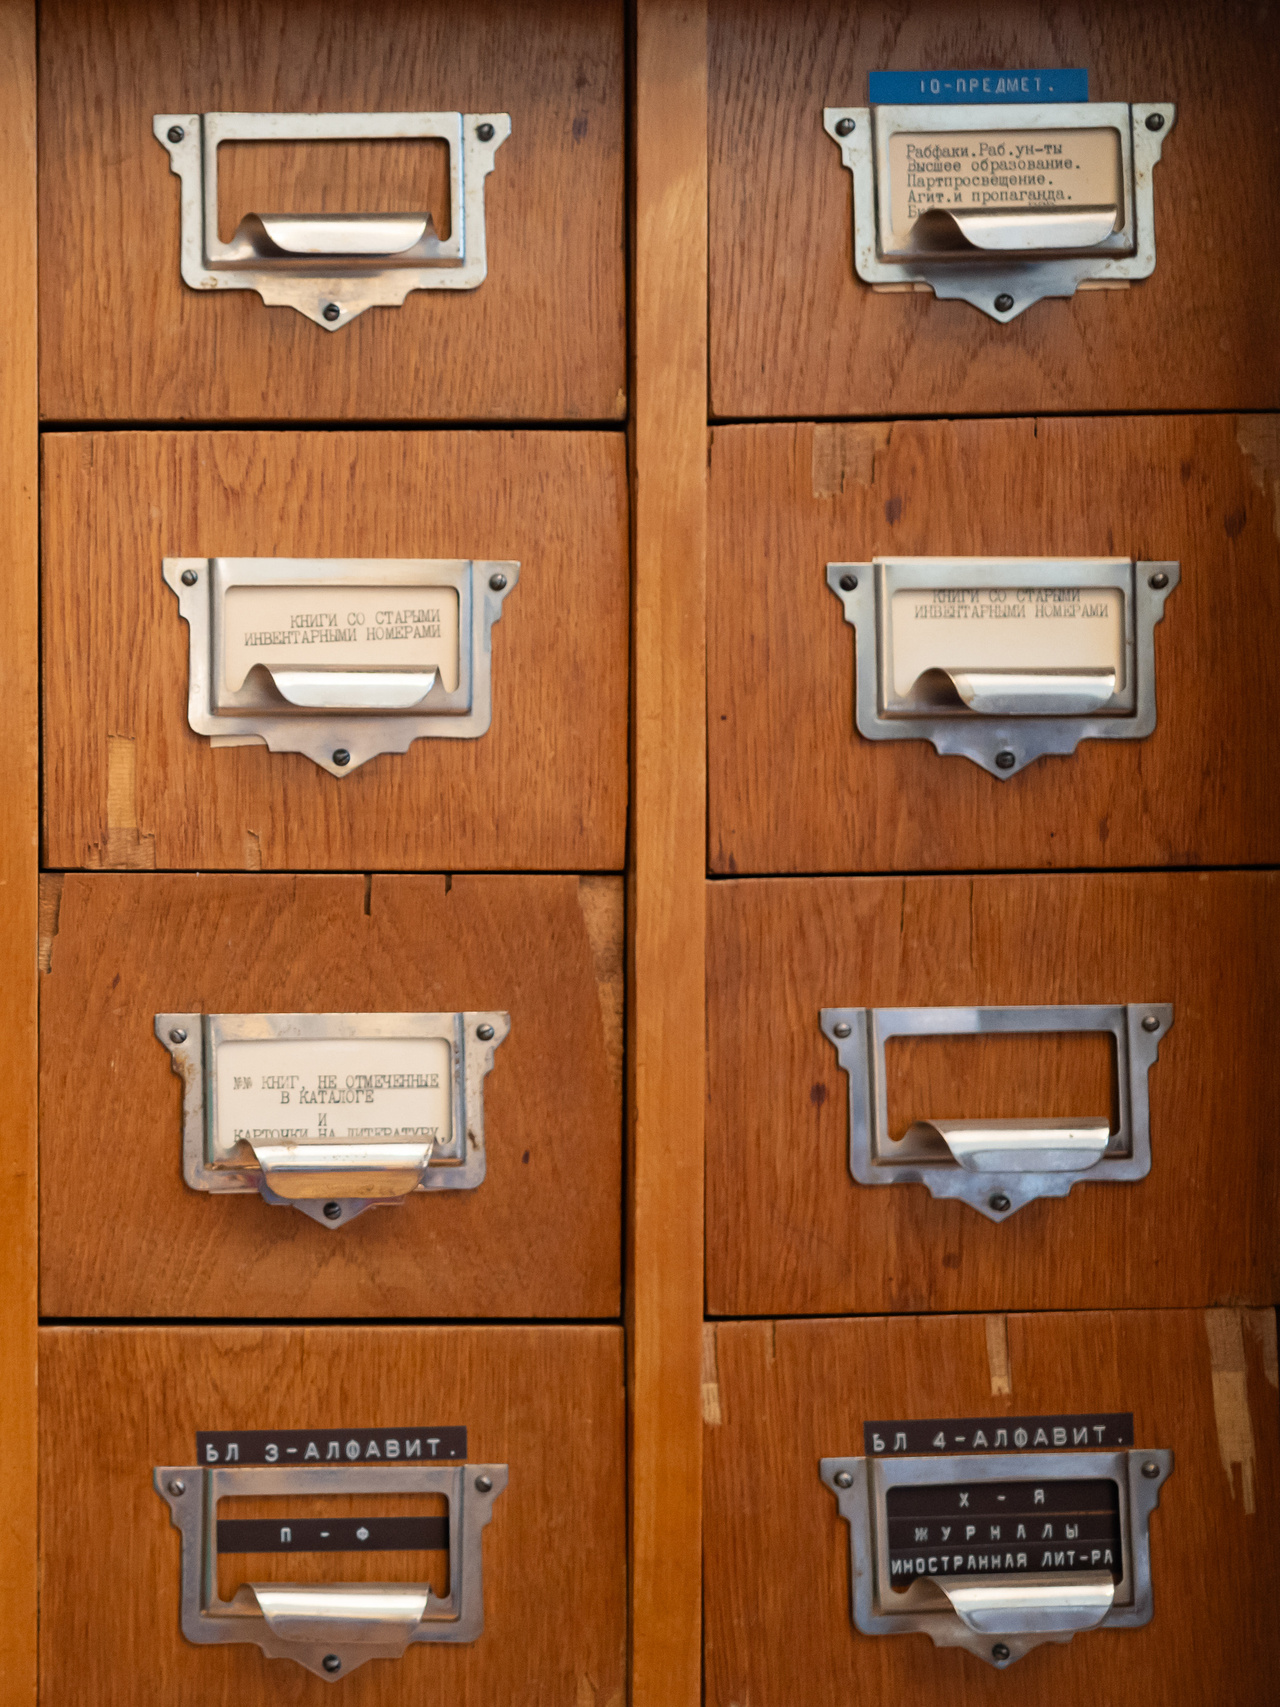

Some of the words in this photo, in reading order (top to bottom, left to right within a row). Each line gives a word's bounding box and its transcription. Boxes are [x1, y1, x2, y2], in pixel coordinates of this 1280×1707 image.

[907, 158, 962, 173] Высшее
[971, 158, 1081, 173] образование.
[907, 173, 1054, 190] Партпросвещение.
[972, 188, 1072, 205] пропаганда.
[932, 588, 980, 603] КНИГИ
[988, 588, 1007, 603] СО
[1016, 588, 1081, 603] СТАРЫМИ
[290, 613, 338, 628] КНИГИ
[347, 612, 365, 625] СО
[375, 609, 441, 624] СТАРЫМИ
[914, 604, 1026, 619] ИНВЕНТАРНЫМИ
[1035, 604, 1109, 618] НОМЕРАМИ
[244, 629, 357, 646] ИНВЕНТАРНЫМИ
[366, 625, 441, 641] НОМЕРАМИ
[261, 1075, 305, 1092] КНИГ,
[317, 1075, 337, 1089] НЕ
[345, 1073, 439, 1089] ОТМЕЧЕННЫЕ
[280, 1091, 290, 1104] В
[299, 1090, 375, 1105] КАТАЛОГЕ
[317, 1113, 327, 1127] И
[872, 1432, 907, 1452] БЛ
[933, 1426, 1123, 1449] 4-АЛФАВИТ.
[206, 1443, 239, 1462] БЛ
[265, 1438, 456, 1462] 3-АЛФАВИТ.
[959, 1492, 969, 1508] Х
[1034, 1489, 1045, 1504] Я
[281, 1527, 291, 1543] П
[356, 1526, 369, 1541] Ф
[891, 1552, 1028, 1575] ИНОСТРАННАЯ
[1041, 1549, 1113, 1568] ЛИТ-РА
